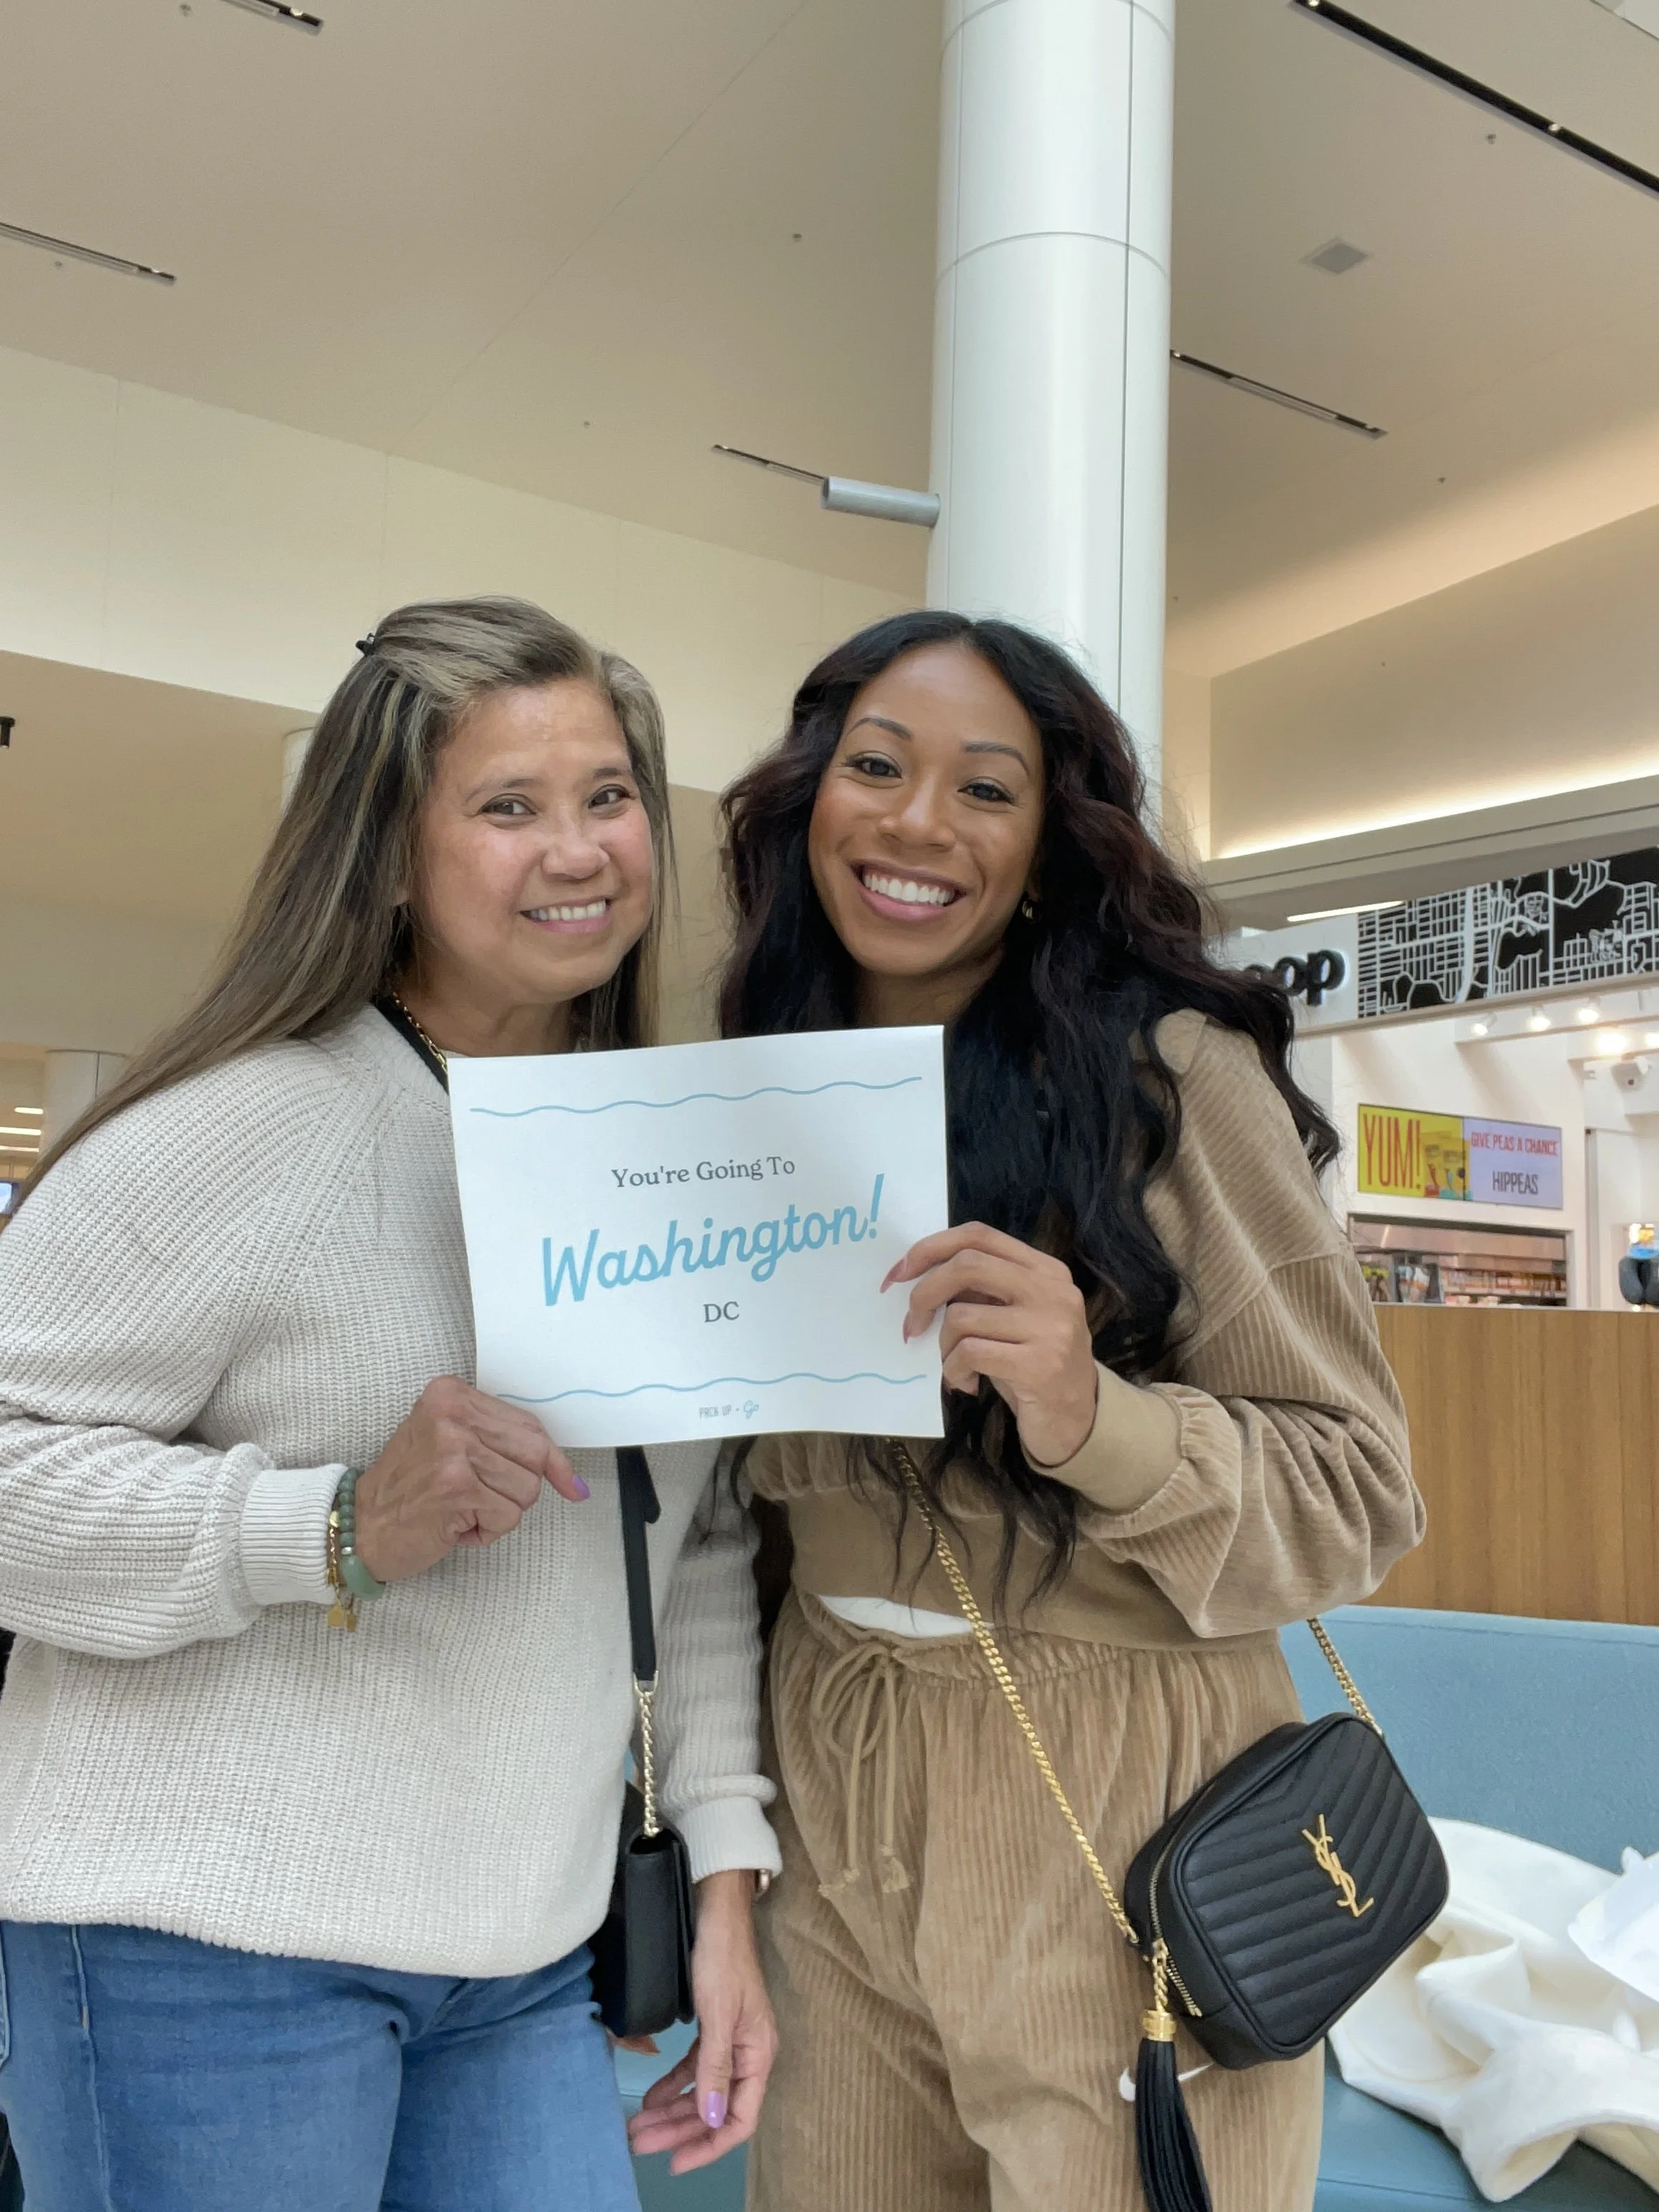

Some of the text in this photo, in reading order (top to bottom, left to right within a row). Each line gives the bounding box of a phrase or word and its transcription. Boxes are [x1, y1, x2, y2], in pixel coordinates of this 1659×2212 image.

[1244, 949, 1346, 1005] op
[1363, 1114, 1421, 1189] YUM!
[1471, 1132, 1558, 1156] GIVE PEAS A CHANCE
[612, 1157, 795, 1187] You're Going To
[1493, 1170, 1539, 1195] HIPPEAS
[542, 1173, 884, 1306] Washington!
[703, 1301, 740, 1323] DC
